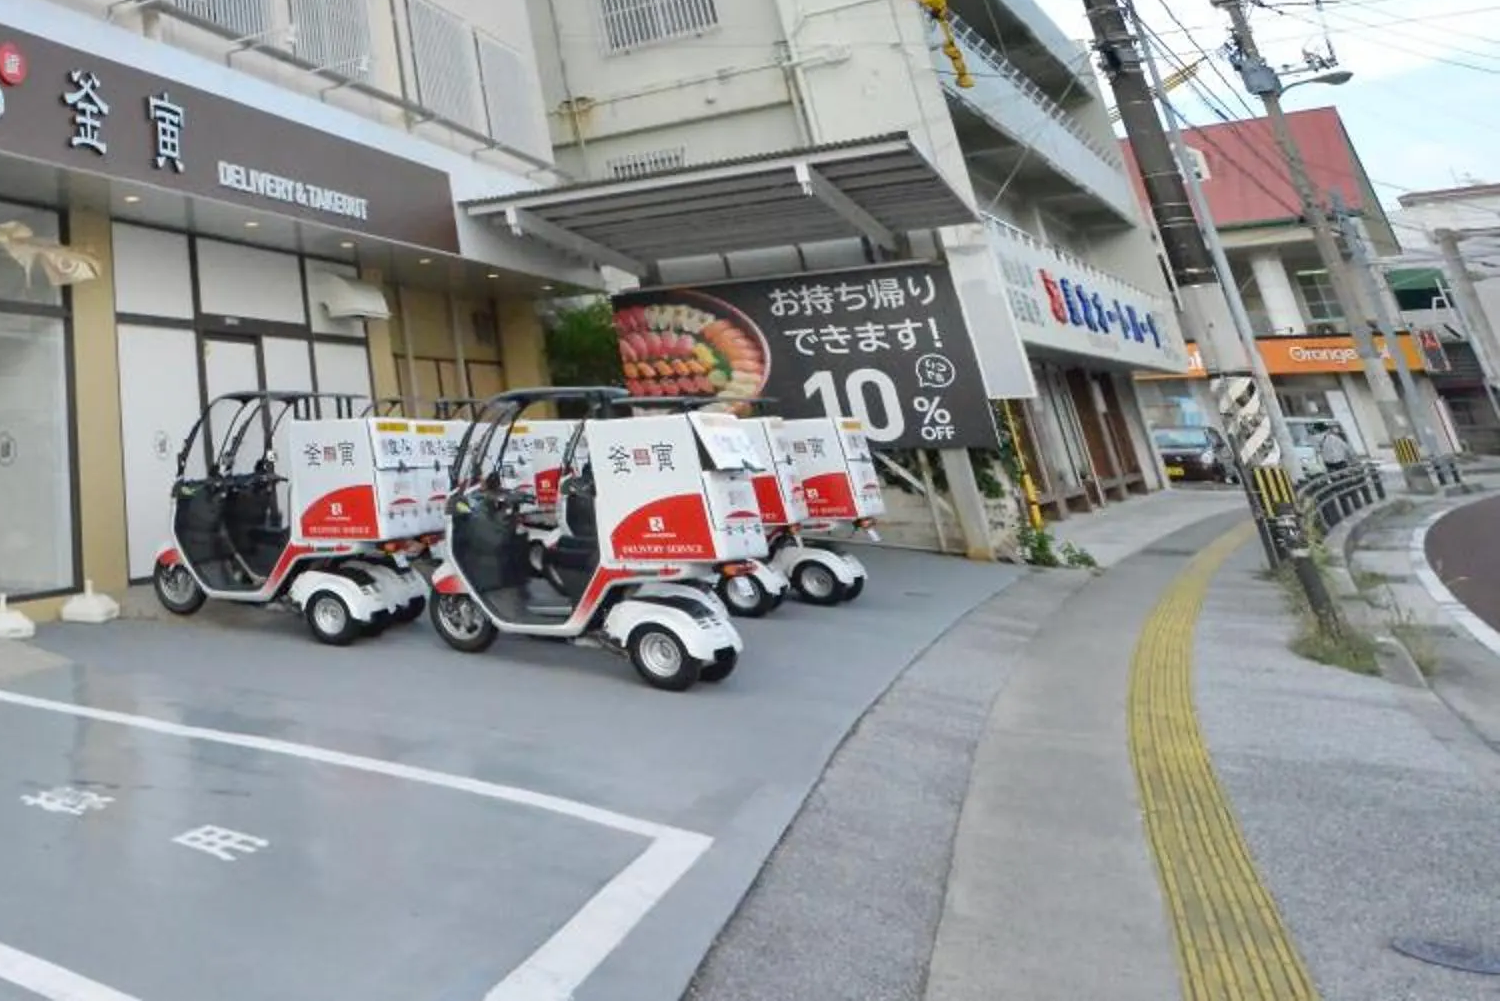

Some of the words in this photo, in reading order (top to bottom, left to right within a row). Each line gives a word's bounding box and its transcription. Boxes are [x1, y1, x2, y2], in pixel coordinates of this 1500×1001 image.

[768, 275, 936, 316] お持ち帰り
[921, 426, 955, 440] OFF
